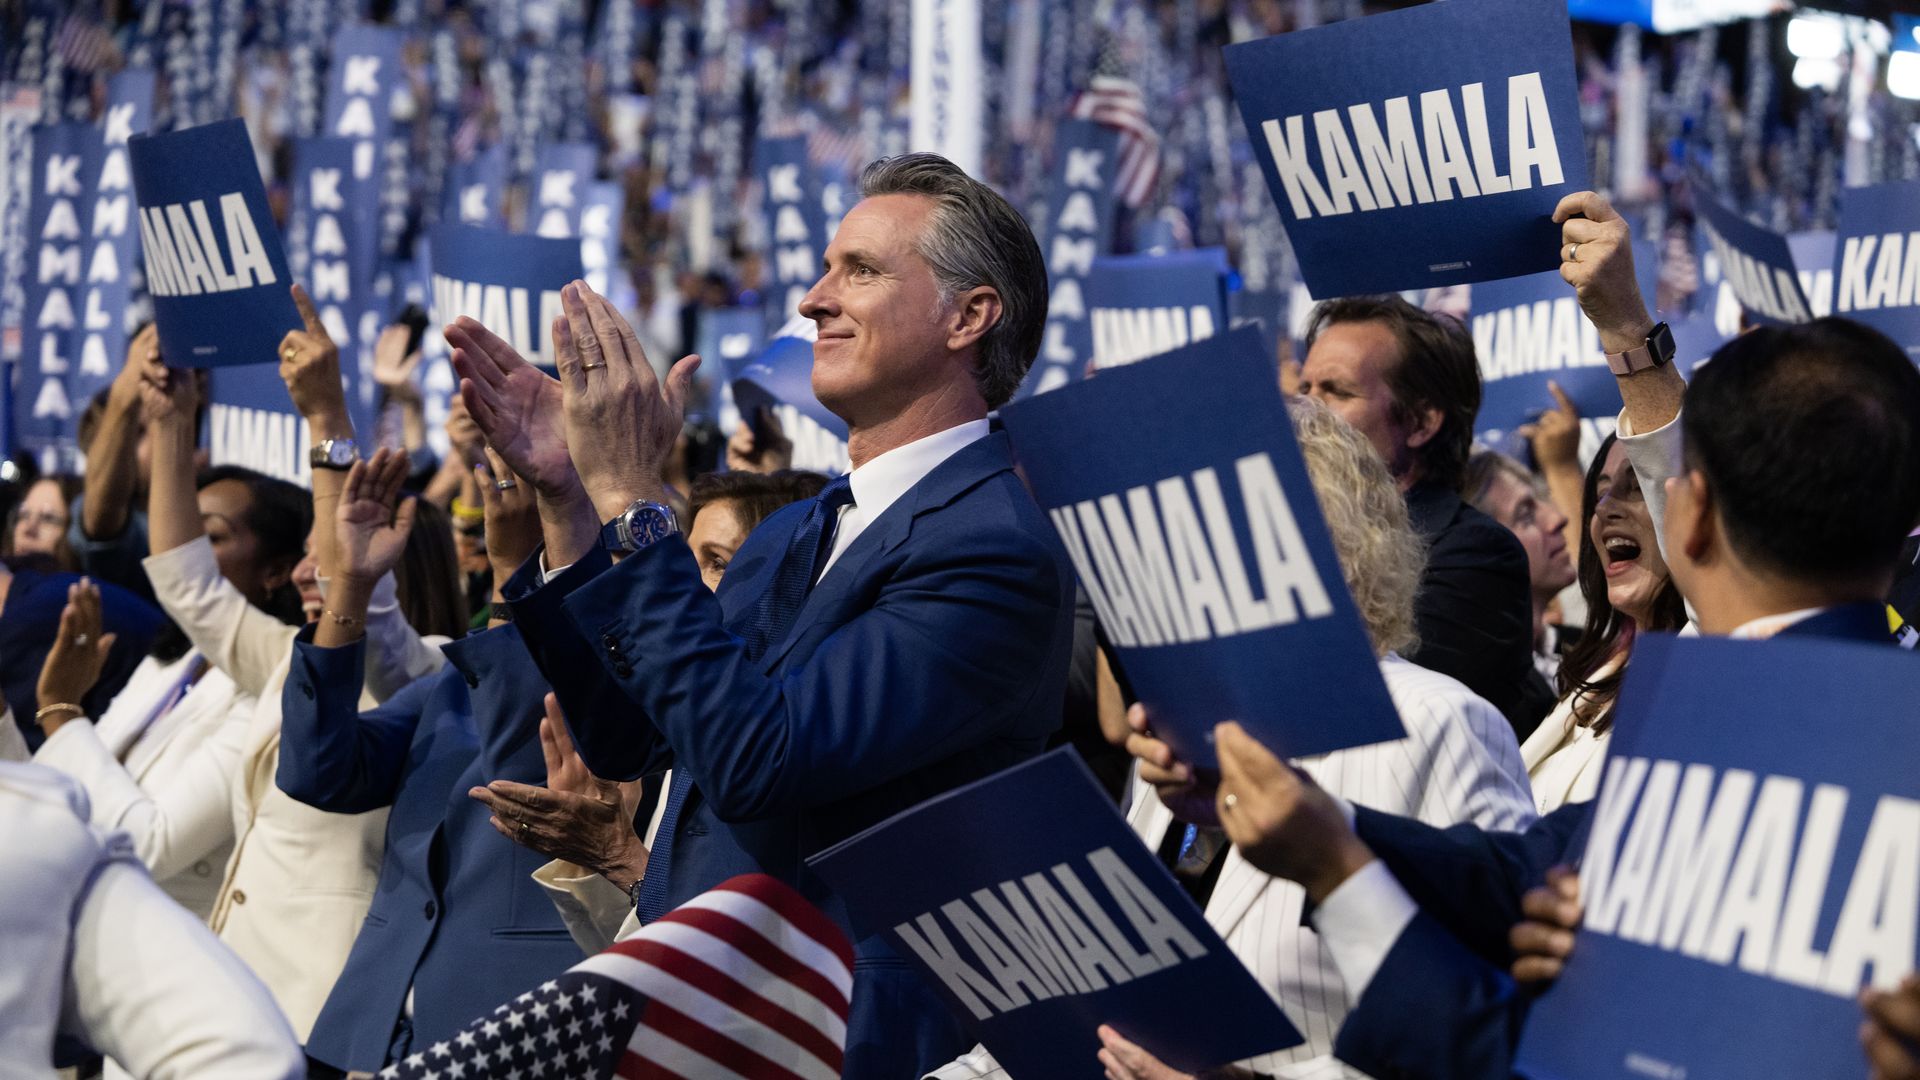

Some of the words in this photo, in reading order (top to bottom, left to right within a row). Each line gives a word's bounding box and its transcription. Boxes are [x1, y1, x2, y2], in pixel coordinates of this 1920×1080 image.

[79, 101, 137, 377] KAMALA
[1261, 71, 1565, 220] KAMALA
[33, 153, 83, 420] KAMALA
[138, 191, 277, 297] MALA
[309, 167, 350, 348] KAMA
[1049, 451, 1334, 648] KAMALA
[893, 846, 1208, 1021] KAMALA
[1577, 755, 1920, 998] KAMALA
